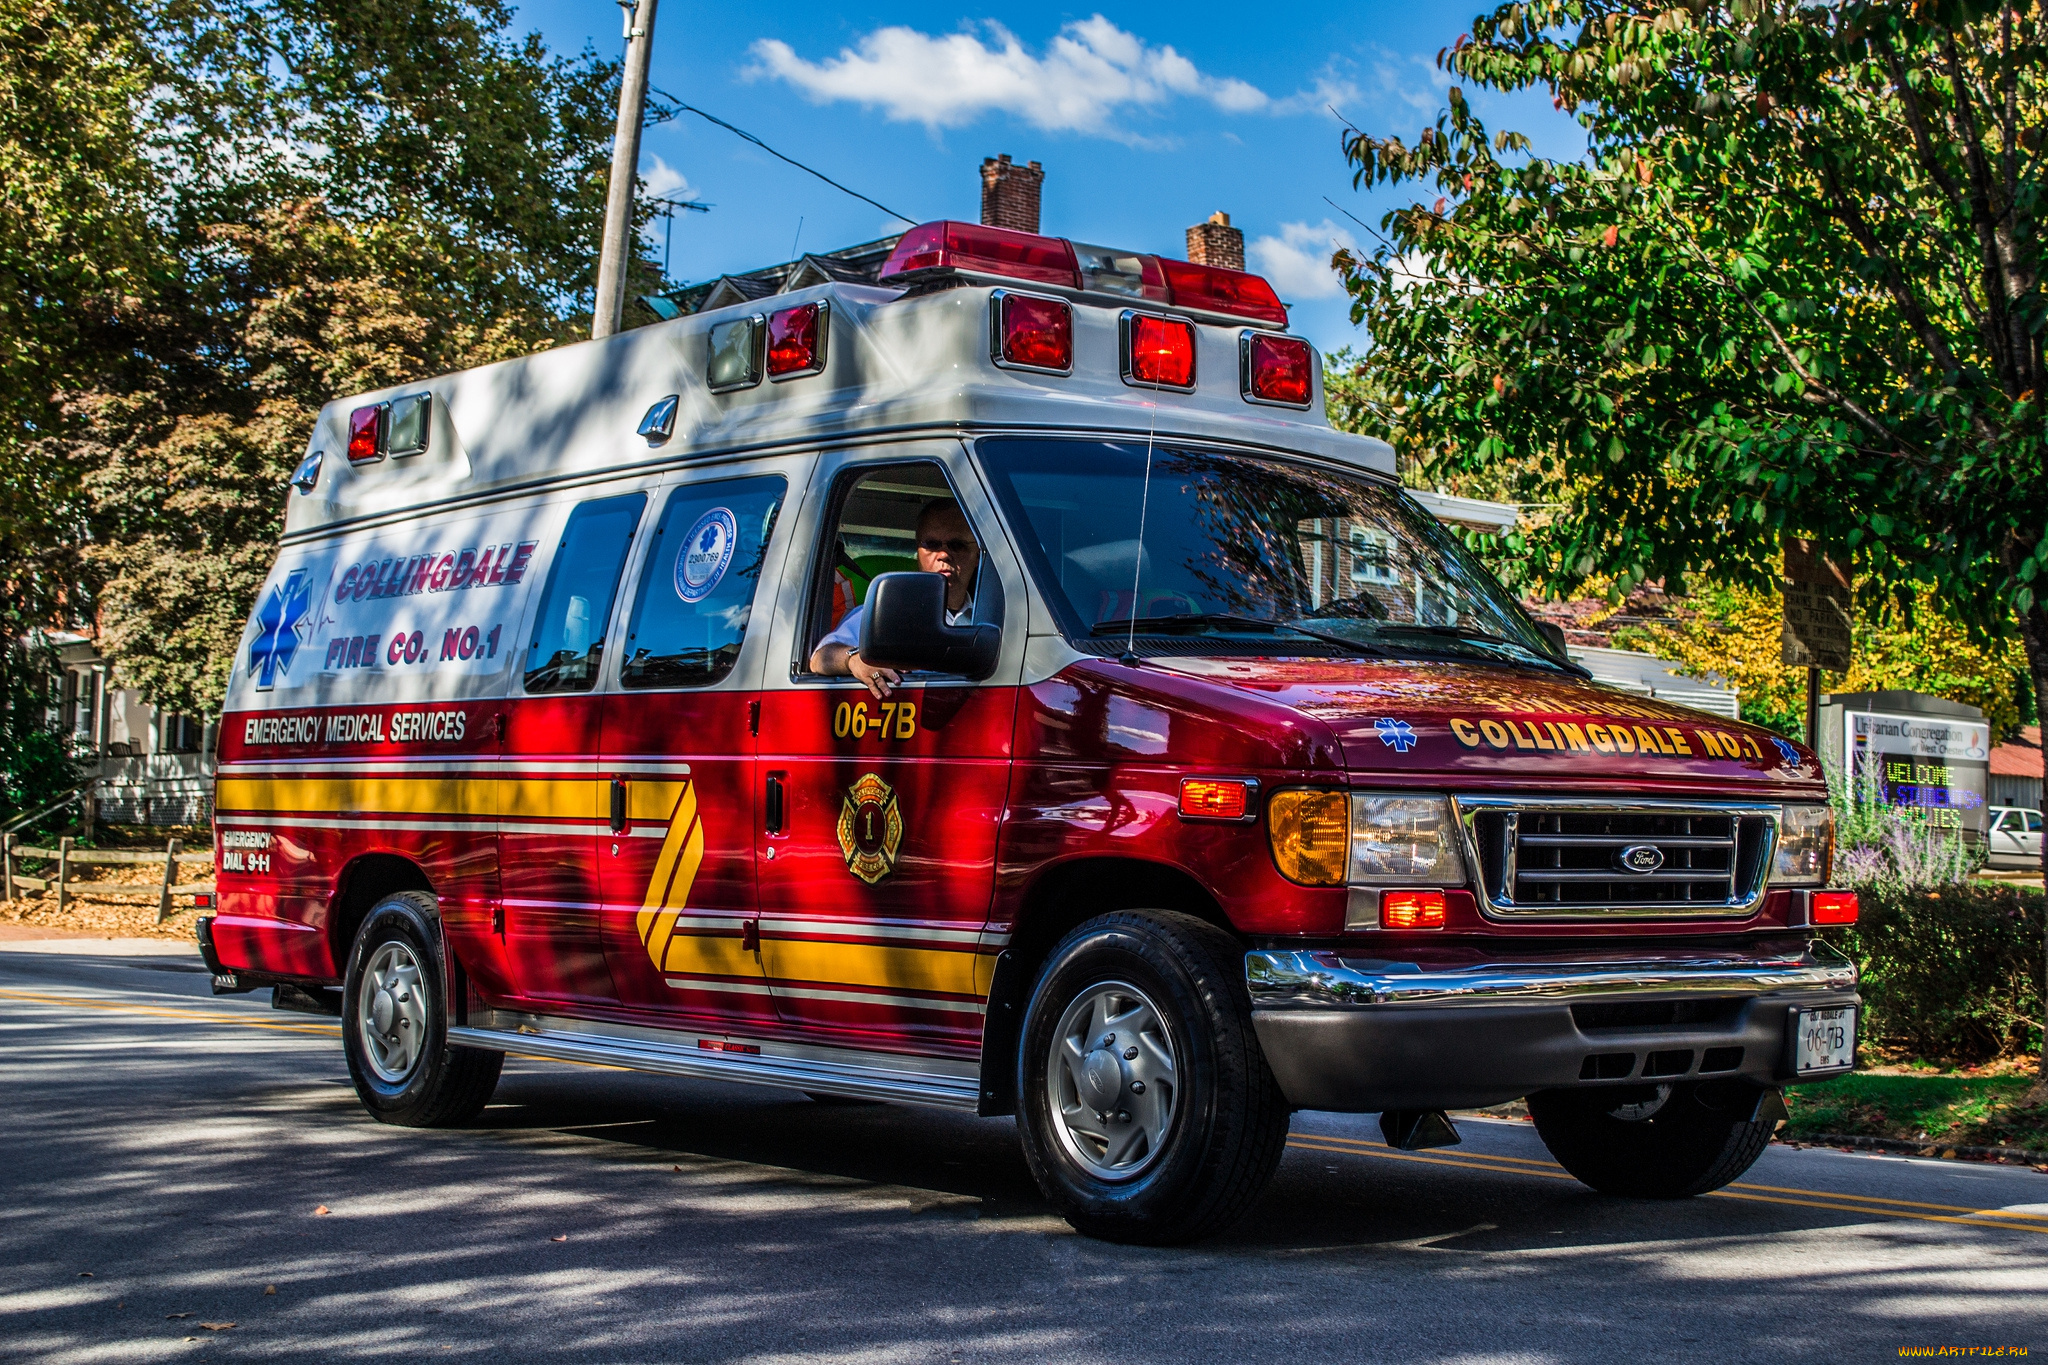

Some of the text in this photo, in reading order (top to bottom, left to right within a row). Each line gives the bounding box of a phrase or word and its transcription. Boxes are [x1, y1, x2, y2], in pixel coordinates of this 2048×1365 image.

[335, 539, 539, 604] COLLINGDALE
[324, 623, 503, 670] FIRE CO. NO.1
[244, 711, 466, 745] EMERGENCY MEDICAL SERVICES
[833, 701, 917, 739] 06-7B
[1901, 721, 1963, 744] Congregation
[1449, 718, 1764, 760] COLLINGDALE NO.1
[1920, 743, 1937, 754] West
[1938, 744, 1964, 756] Chester
[1886, 762, 1955, 786] WELCOME
[866, 811, 873, 840] 1
[223, 830, 271, 849] EMERGENCY
[223, 852, 271, 873] DIAL 9-1-1
[1634, 850, 1655, 865] Ford
[1807, 1026, 1844, 1052] 06-7B
[1820, 1055, 1830, 1065] EMS
